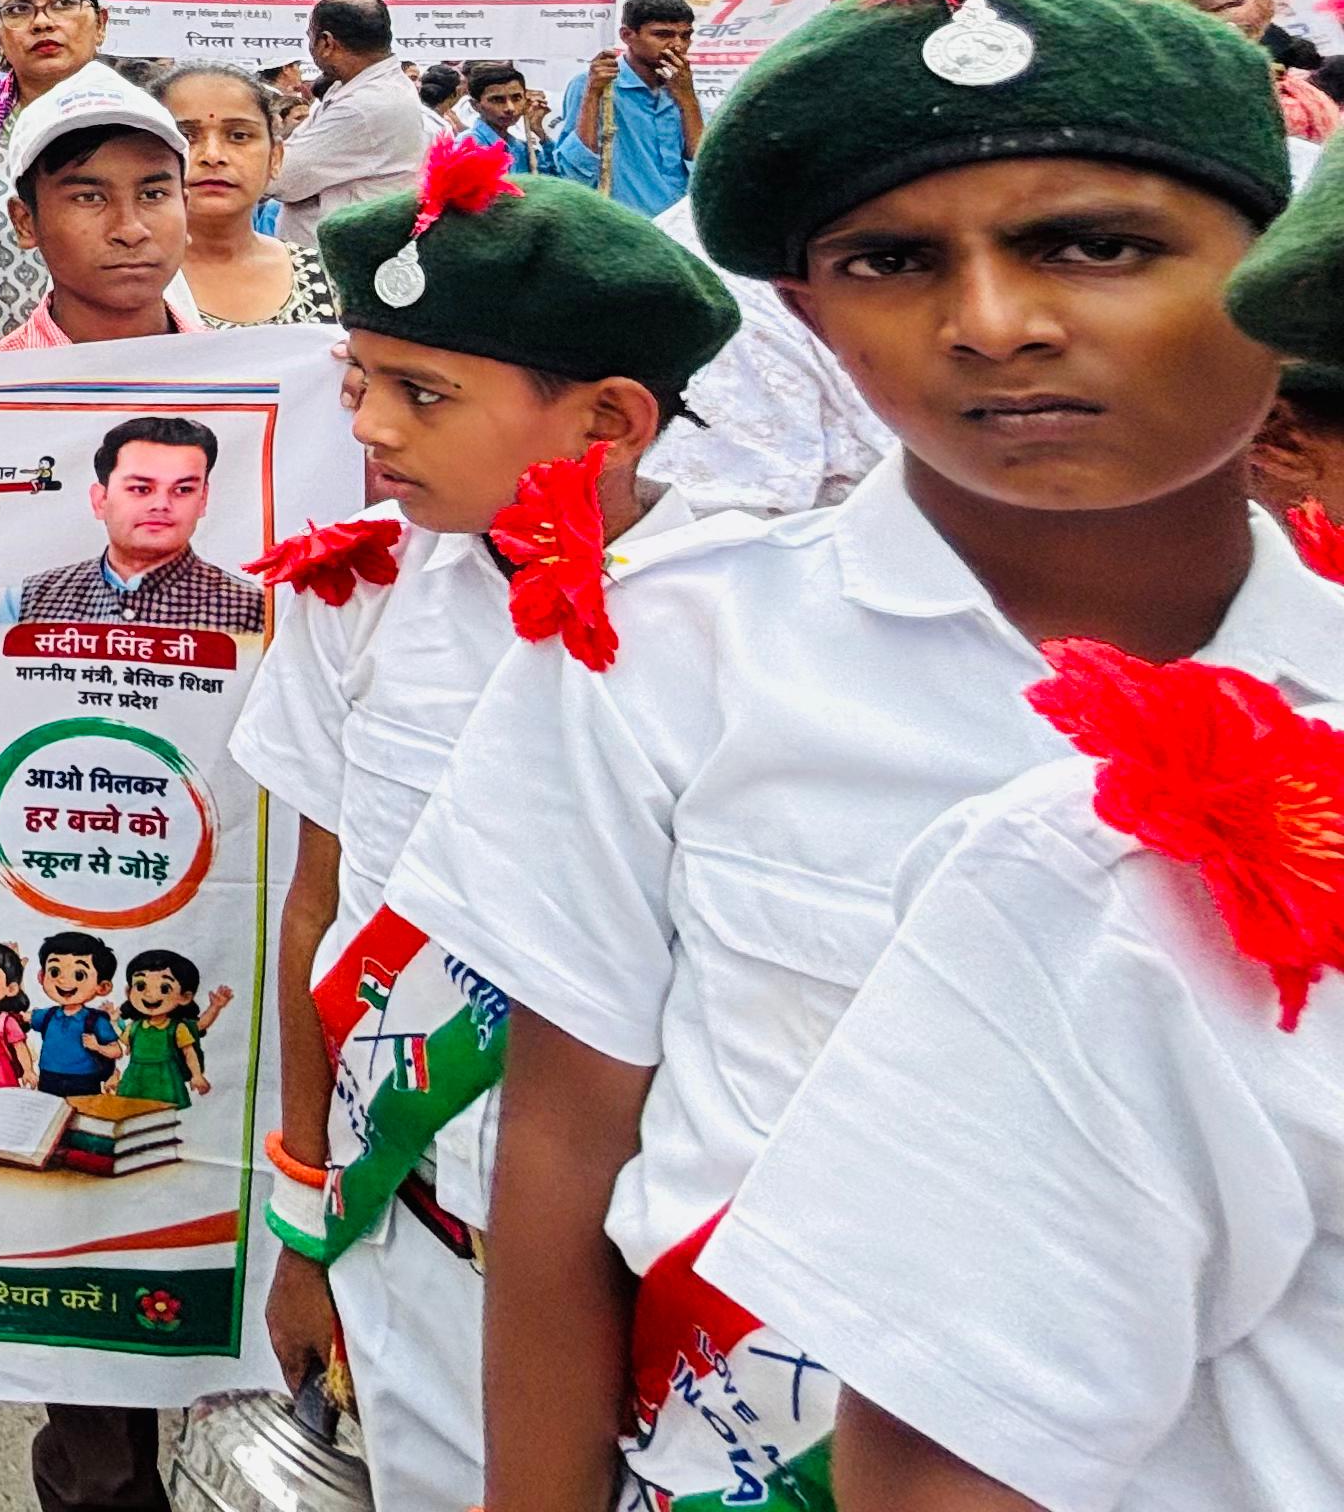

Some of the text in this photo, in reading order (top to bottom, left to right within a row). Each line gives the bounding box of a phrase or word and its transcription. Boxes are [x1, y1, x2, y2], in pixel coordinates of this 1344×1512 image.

[186, 31, 232, 48] जिला
[35, 630, 196, 662] संदीप सिंह जी
[16, 665, 224, 695] माननीय मंत्री, बेसिक शिक्षा
[78, 691, 158, 711] उत्तर प्रदेश
[26, 765, 167, 798] आओ मिलकर
[25, 805, 167, 839] हर बच्चे को
[23, 849, 170, 888] स्कूल से जोड़ें
